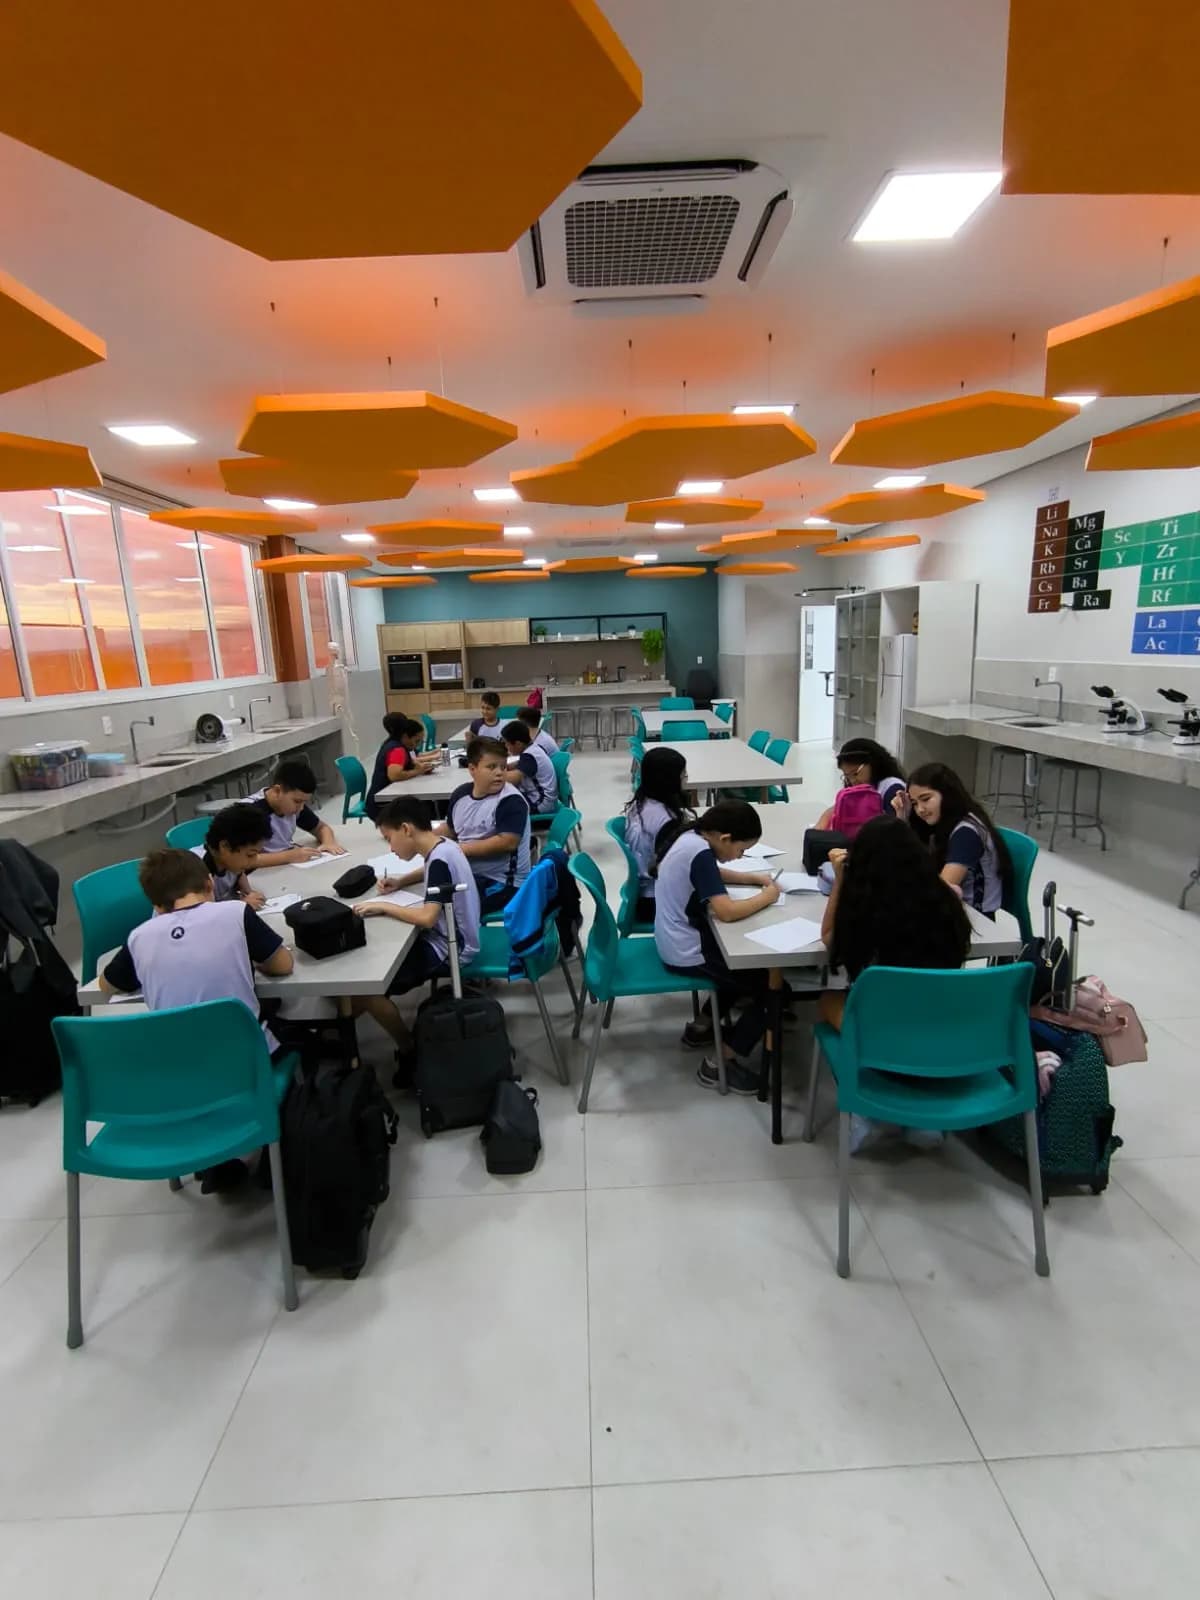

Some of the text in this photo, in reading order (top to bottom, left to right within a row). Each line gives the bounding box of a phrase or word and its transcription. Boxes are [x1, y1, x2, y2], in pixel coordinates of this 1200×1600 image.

[1047, 507, 1058, 519] Li
[1075, 516, 1096, 531] Mg
[1161, 520, 1178, 536] Ti
[1042, 526, 1058, 538] Na
[1114, 530, 1131, 544] Sc
[1044, 543, 1054, 556] K
[1075, 536, 1091, 550] Ca
[1116, 551, 1126, 564] Y
[1156, 544, 1177, 559] Zr
[1039, 562, 1056, 575] Rb
[1073, 557, 1088, 570] Sr
[1152, 565, 1176, 581] Hf
[1038, 581, 1053, 592] Cs
[1072, 577, 1087, 589] Ba
[1083, 594, 1100, 607] Ra
[1151, 588, 1172, 603] Rf
[1038, 599, 1050, 610] Fr
[1148, 615, 1167, 629] La
[1144, 636, 1167, 650] Ac
